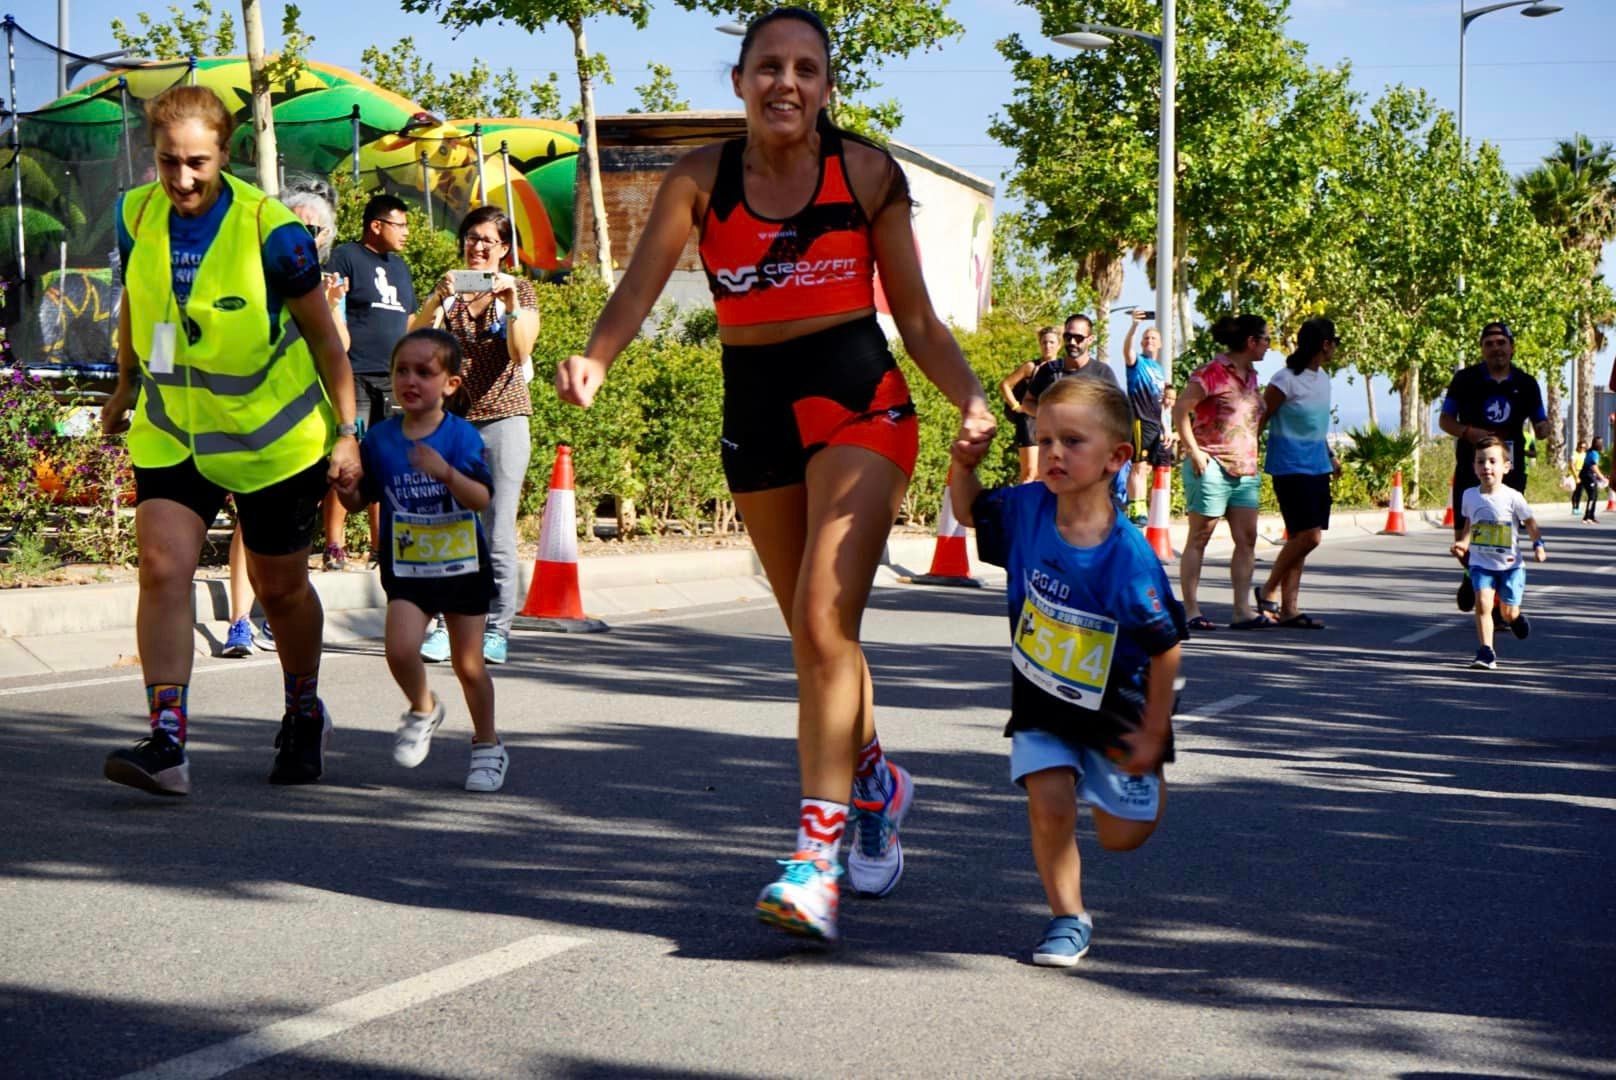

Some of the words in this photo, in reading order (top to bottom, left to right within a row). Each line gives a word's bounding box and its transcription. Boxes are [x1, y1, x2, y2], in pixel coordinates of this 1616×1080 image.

[763, 258, 857, 275] CROSSFIT
[418, 529, 473, 559] 523
[1034, 626, 1105, 681] 514
